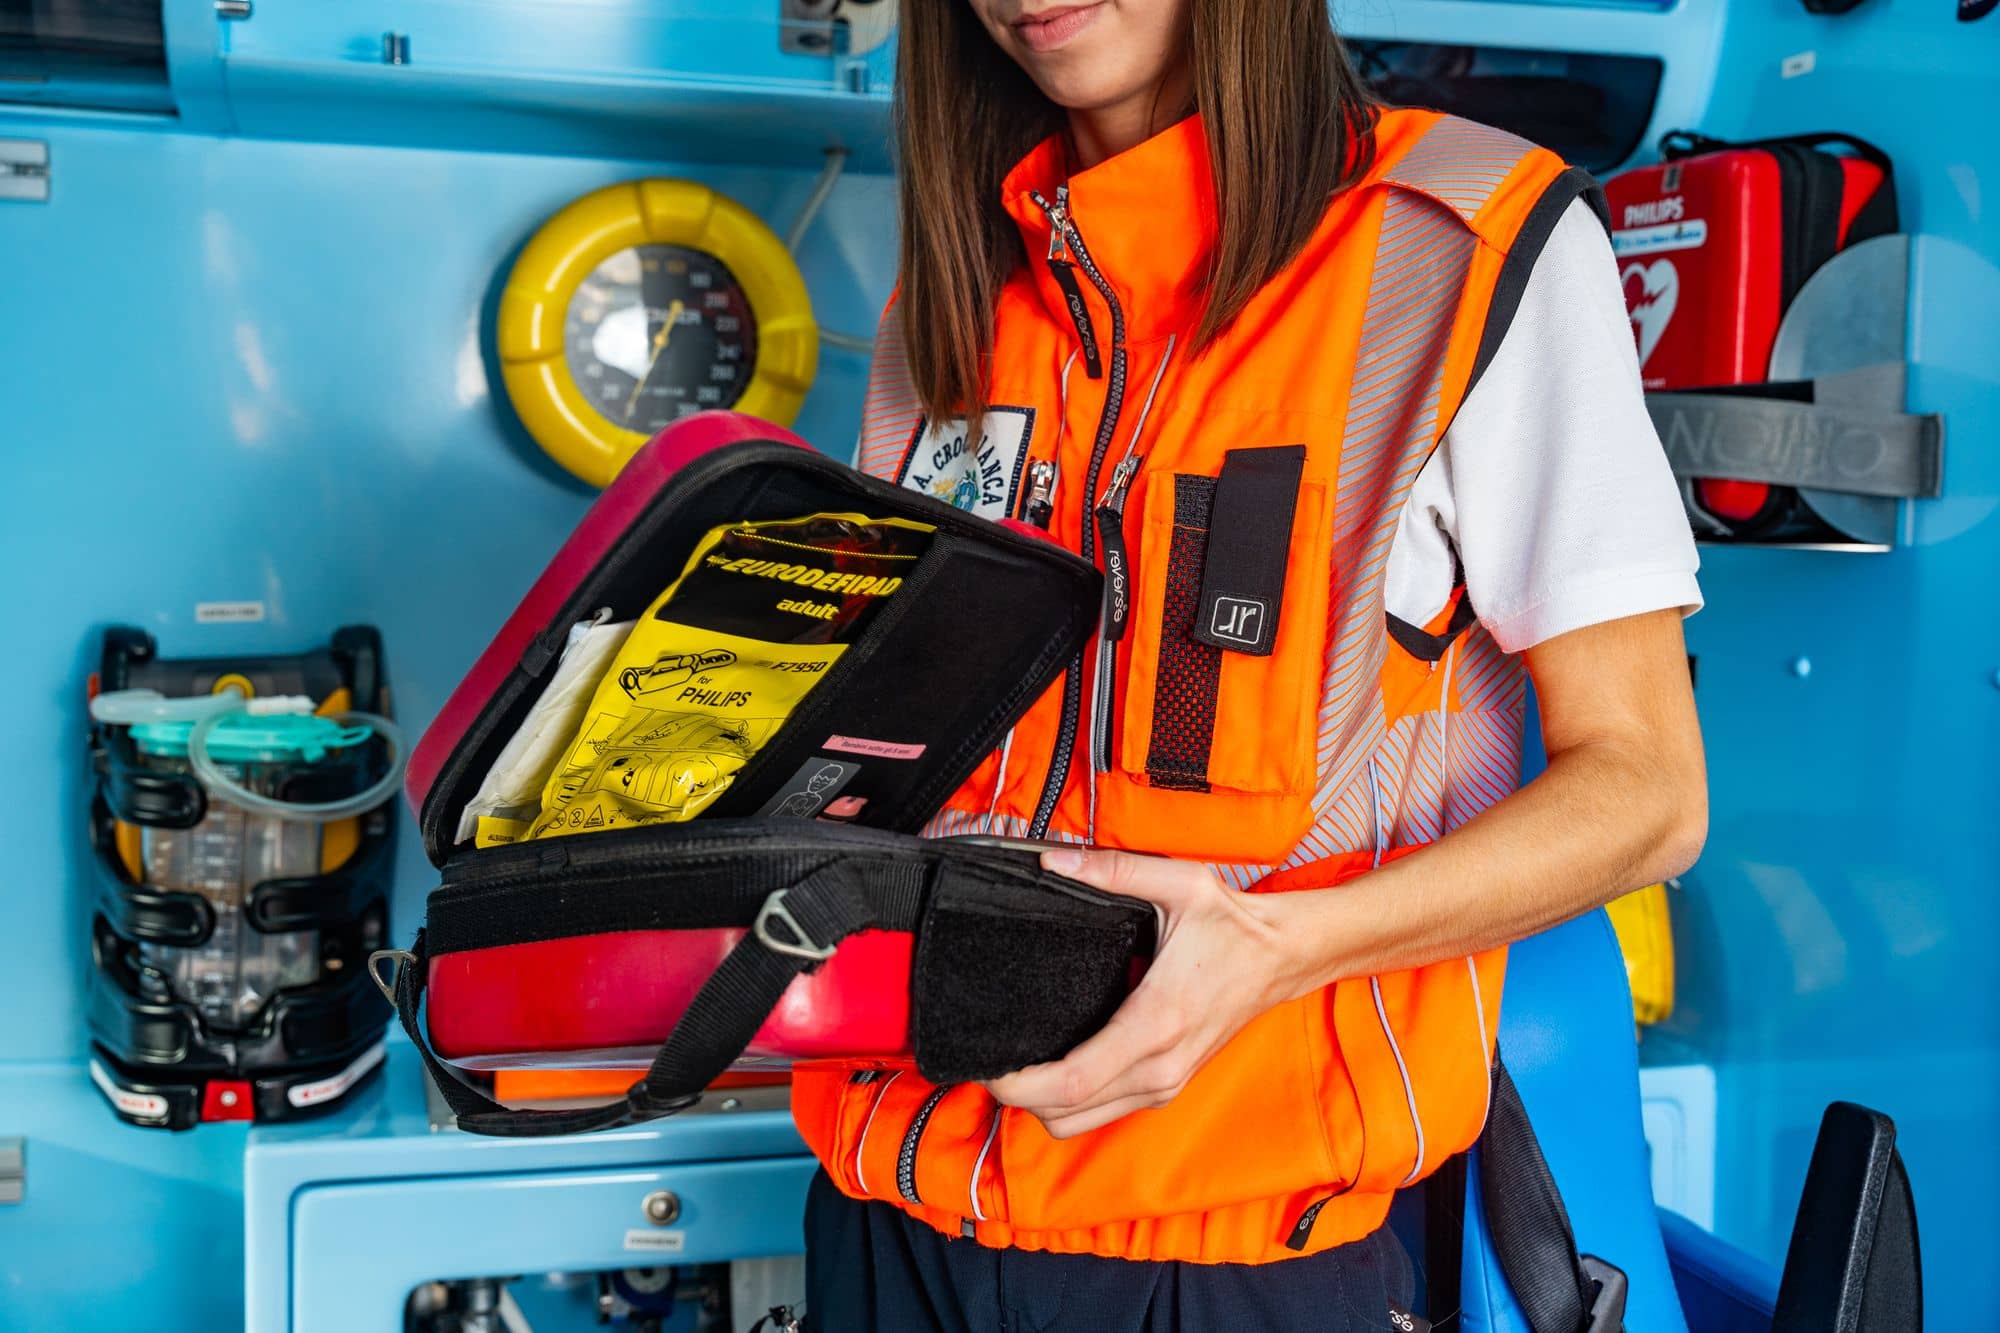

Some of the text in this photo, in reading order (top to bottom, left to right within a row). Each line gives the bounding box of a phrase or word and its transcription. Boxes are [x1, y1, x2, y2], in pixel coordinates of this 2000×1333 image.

[1624, 195, 1684, 228] PHILIPS
[1068, 293, 1095, 360] reverse
[721, 558, 903, 596] EURODEFIPAD
[1109, 550, 1125, 622] reverse
[776, 598, 840, 621] adult
[696, 676, 713, 685] for
[771, 660, 829, 673] F7950
[676, 687, 752, 708] PHILIPS
